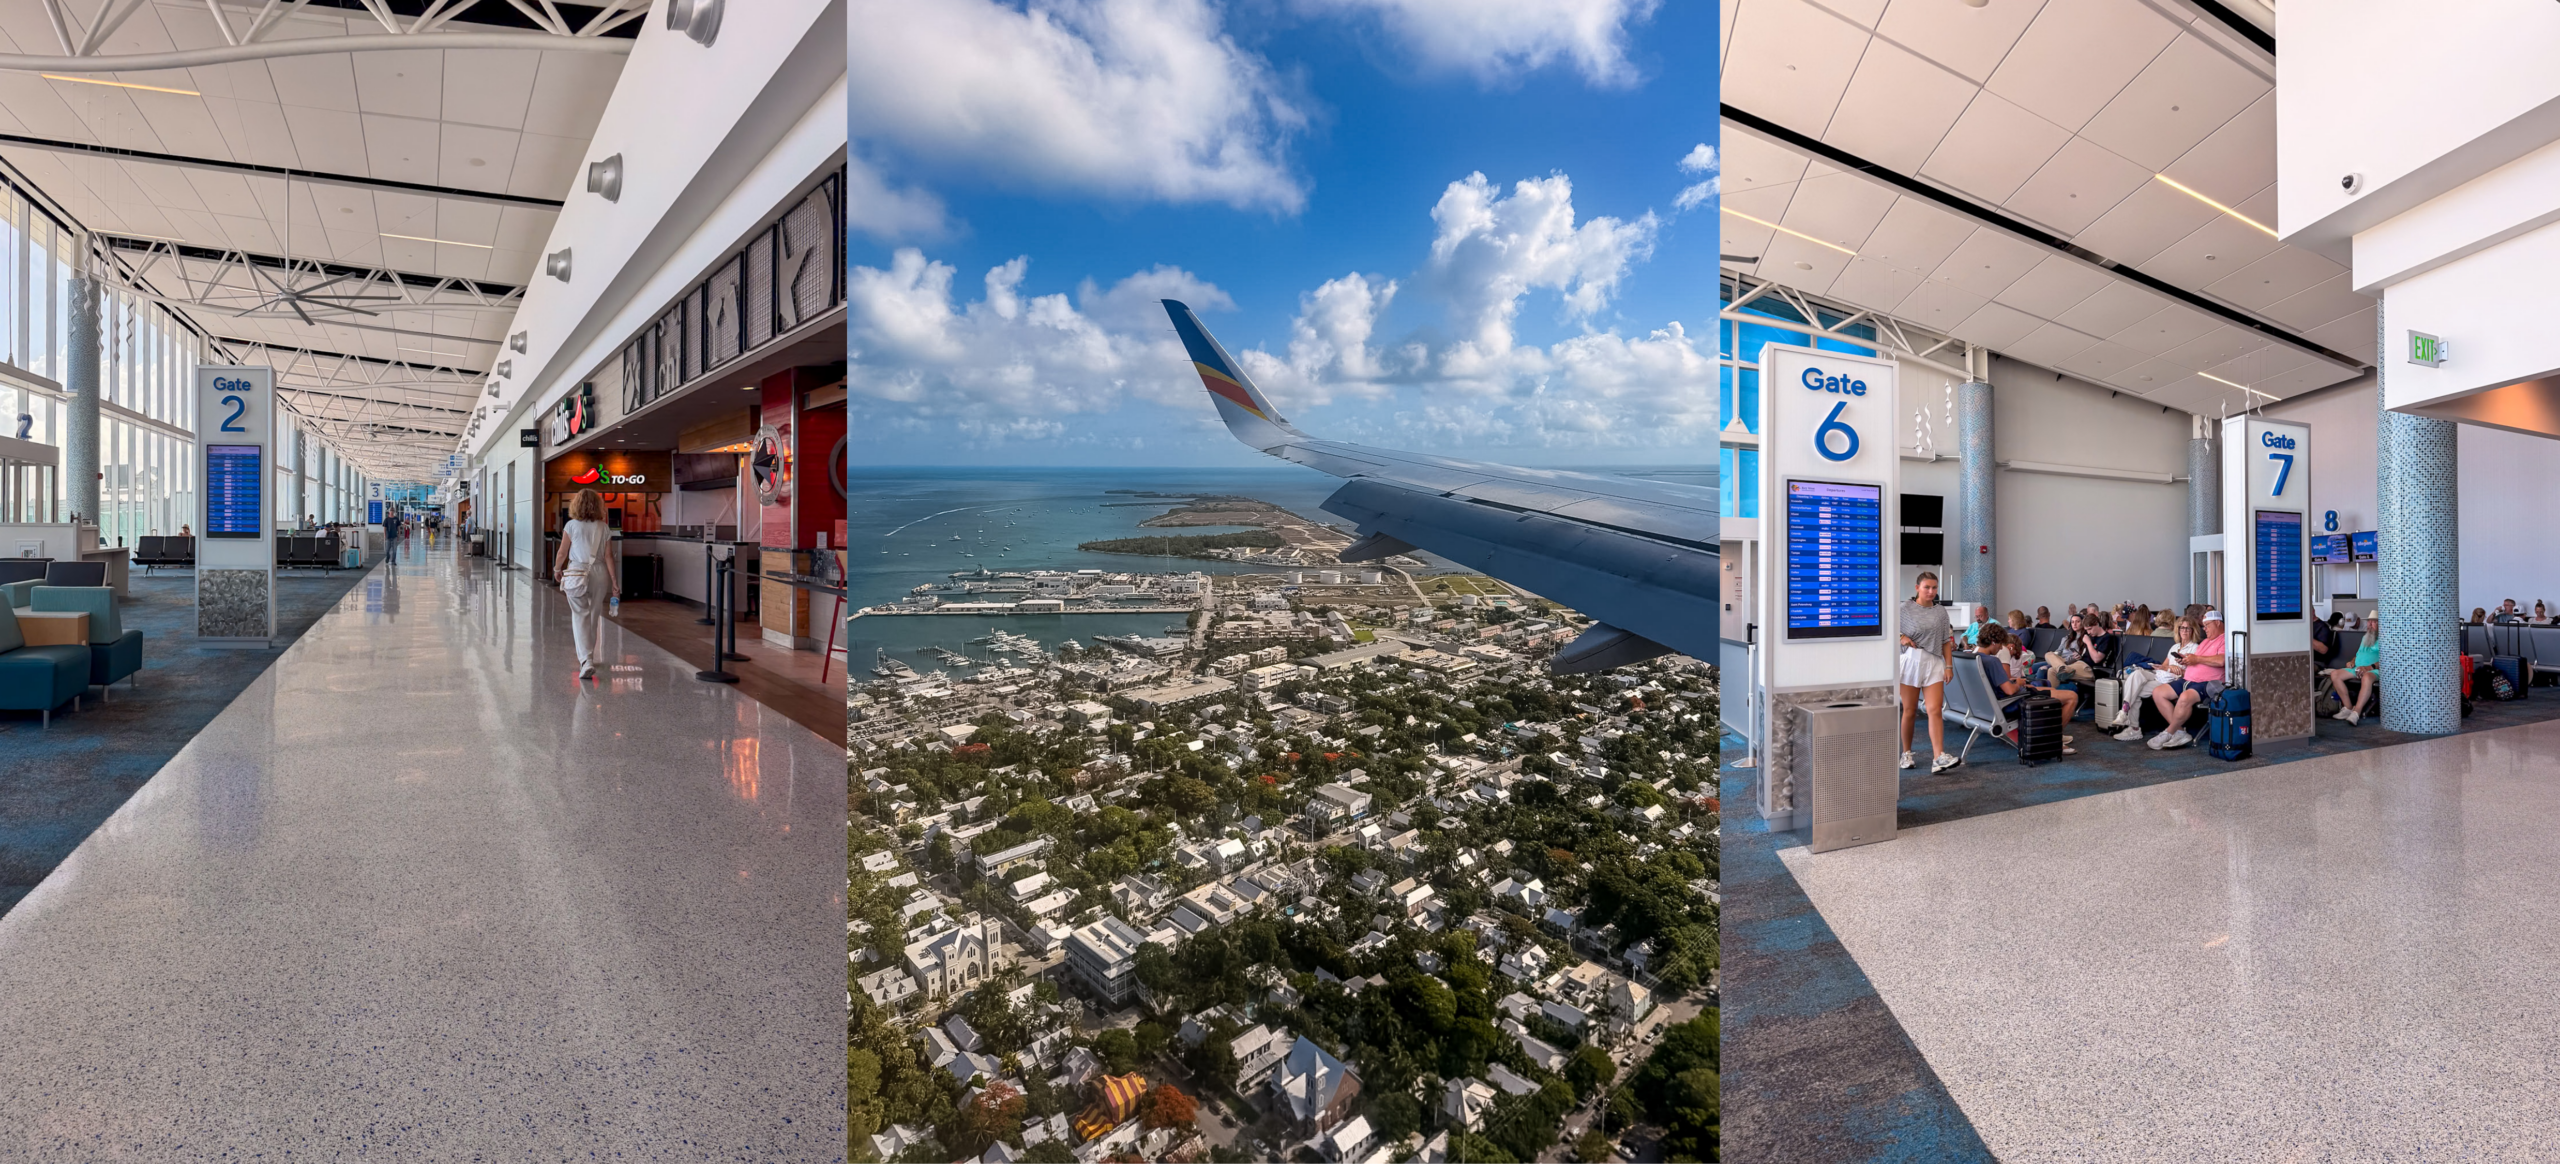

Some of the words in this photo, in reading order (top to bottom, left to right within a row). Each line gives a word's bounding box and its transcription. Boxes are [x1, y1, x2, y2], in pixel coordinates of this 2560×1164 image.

[2414, 335, 2435, 363] EXIT
[213, 376, 251, 392] Gate
[1801, 366, 1867, 397] Gate
[16, 412, 34, 440] 2
[220, 394, 246, 433] 2
[1813, 400, 1861, 462] 6
[2261, 431, 2296, 450] Gate
[2268, 452, 2294, 497] 7
[372, 487, 380, 498] 3
[2324, 510, 2340, 532] 8
